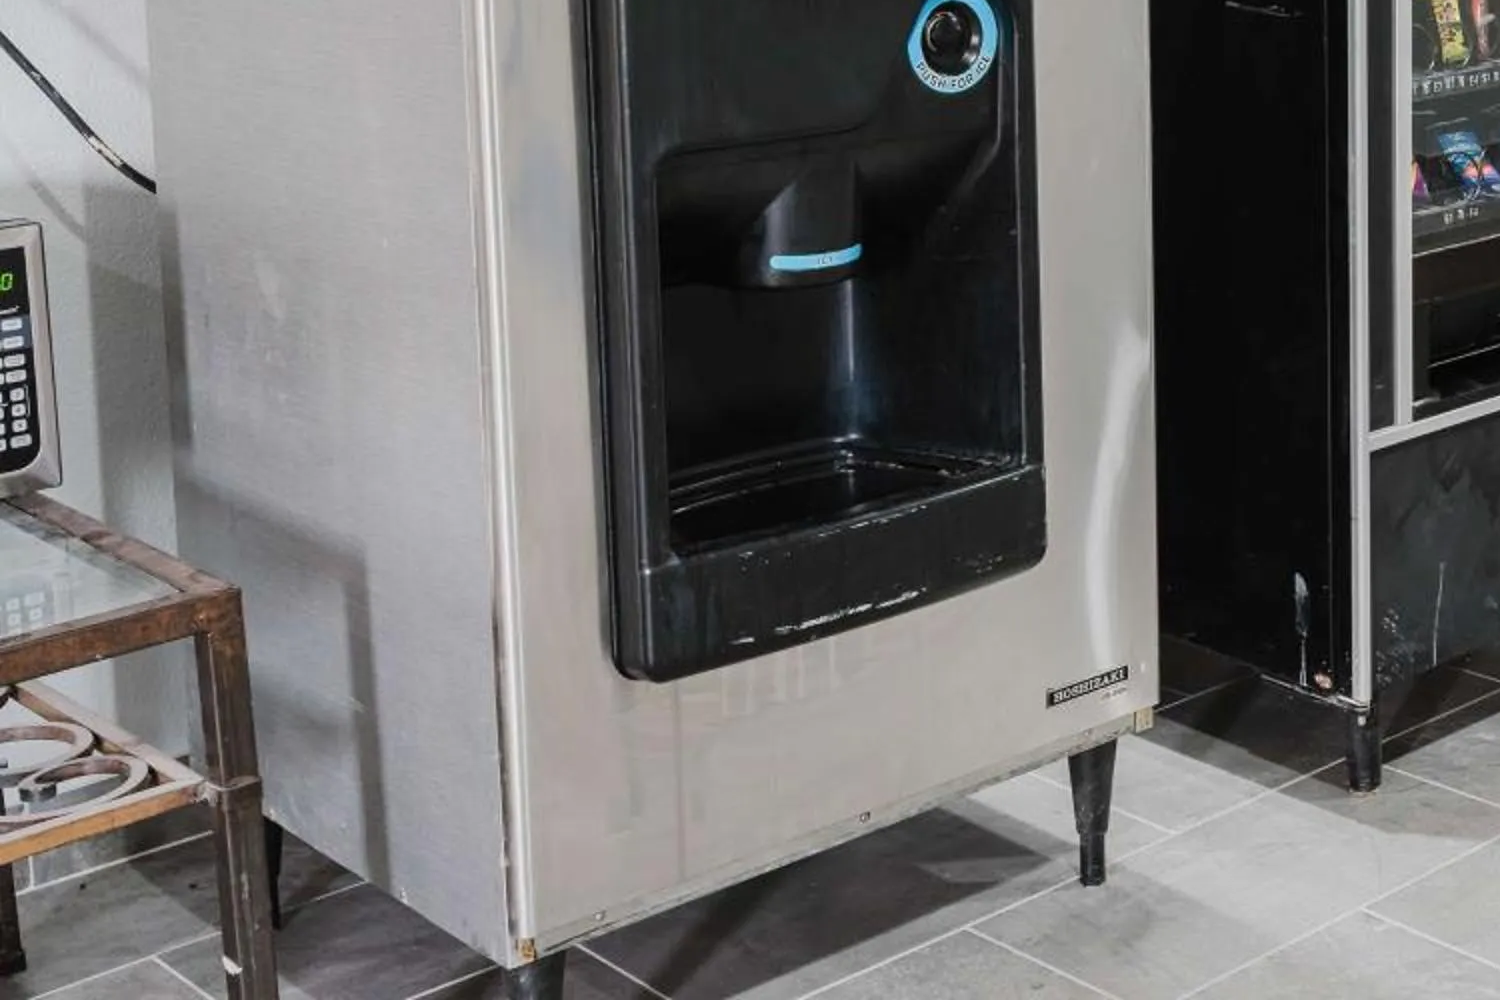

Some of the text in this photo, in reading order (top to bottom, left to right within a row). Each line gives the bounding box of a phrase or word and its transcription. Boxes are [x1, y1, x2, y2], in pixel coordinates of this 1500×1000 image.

[916, 55, 991, 89] PUSH FOR ICE
[1053, 668, 1126, 704] HOSHIZAKI
